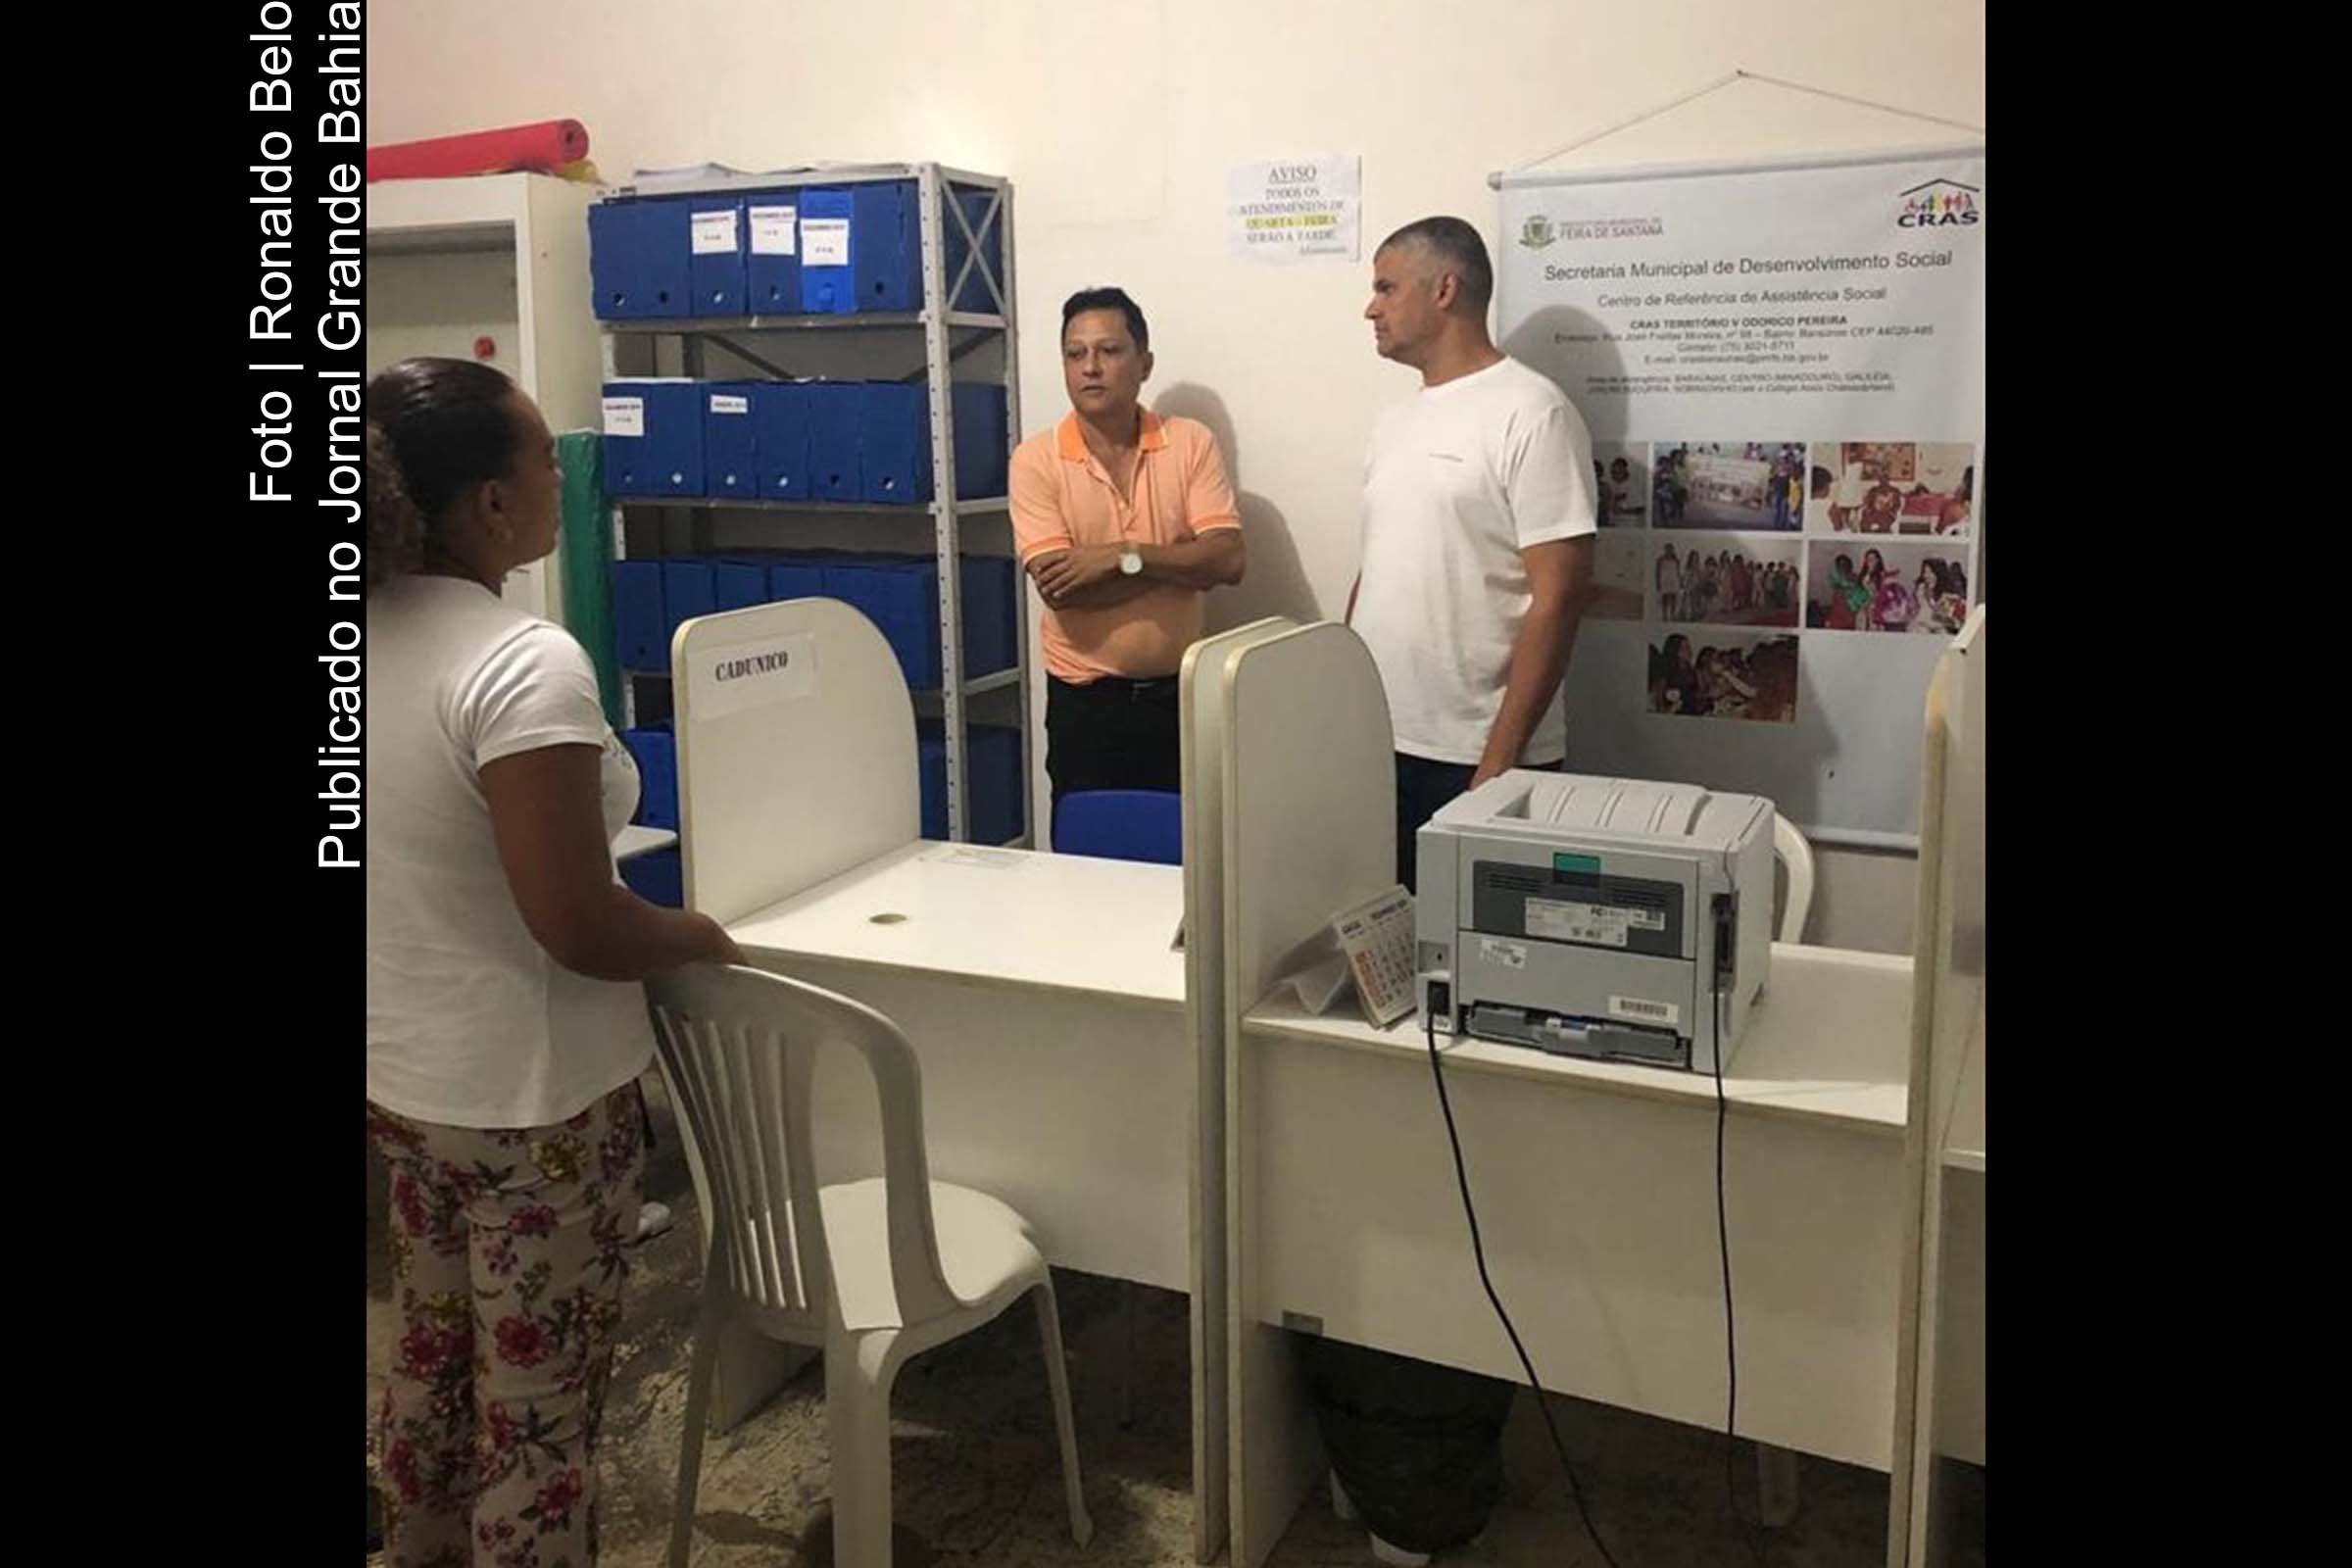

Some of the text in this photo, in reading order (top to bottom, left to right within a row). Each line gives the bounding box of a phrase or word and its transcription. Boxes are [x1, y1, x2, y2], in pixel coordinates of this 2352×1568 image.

[1268, 166, 1318, 183] AVISO
[1265, 187, 1320, 200] TODOS OS
[1897, 210, 1980, 228] CRAS
[1544, 250, 1953, 281] Secretaria Municipal de Desenvolvimento Social
[1597, 287, 1886, 308] Centro de Referência de Assistência Social
